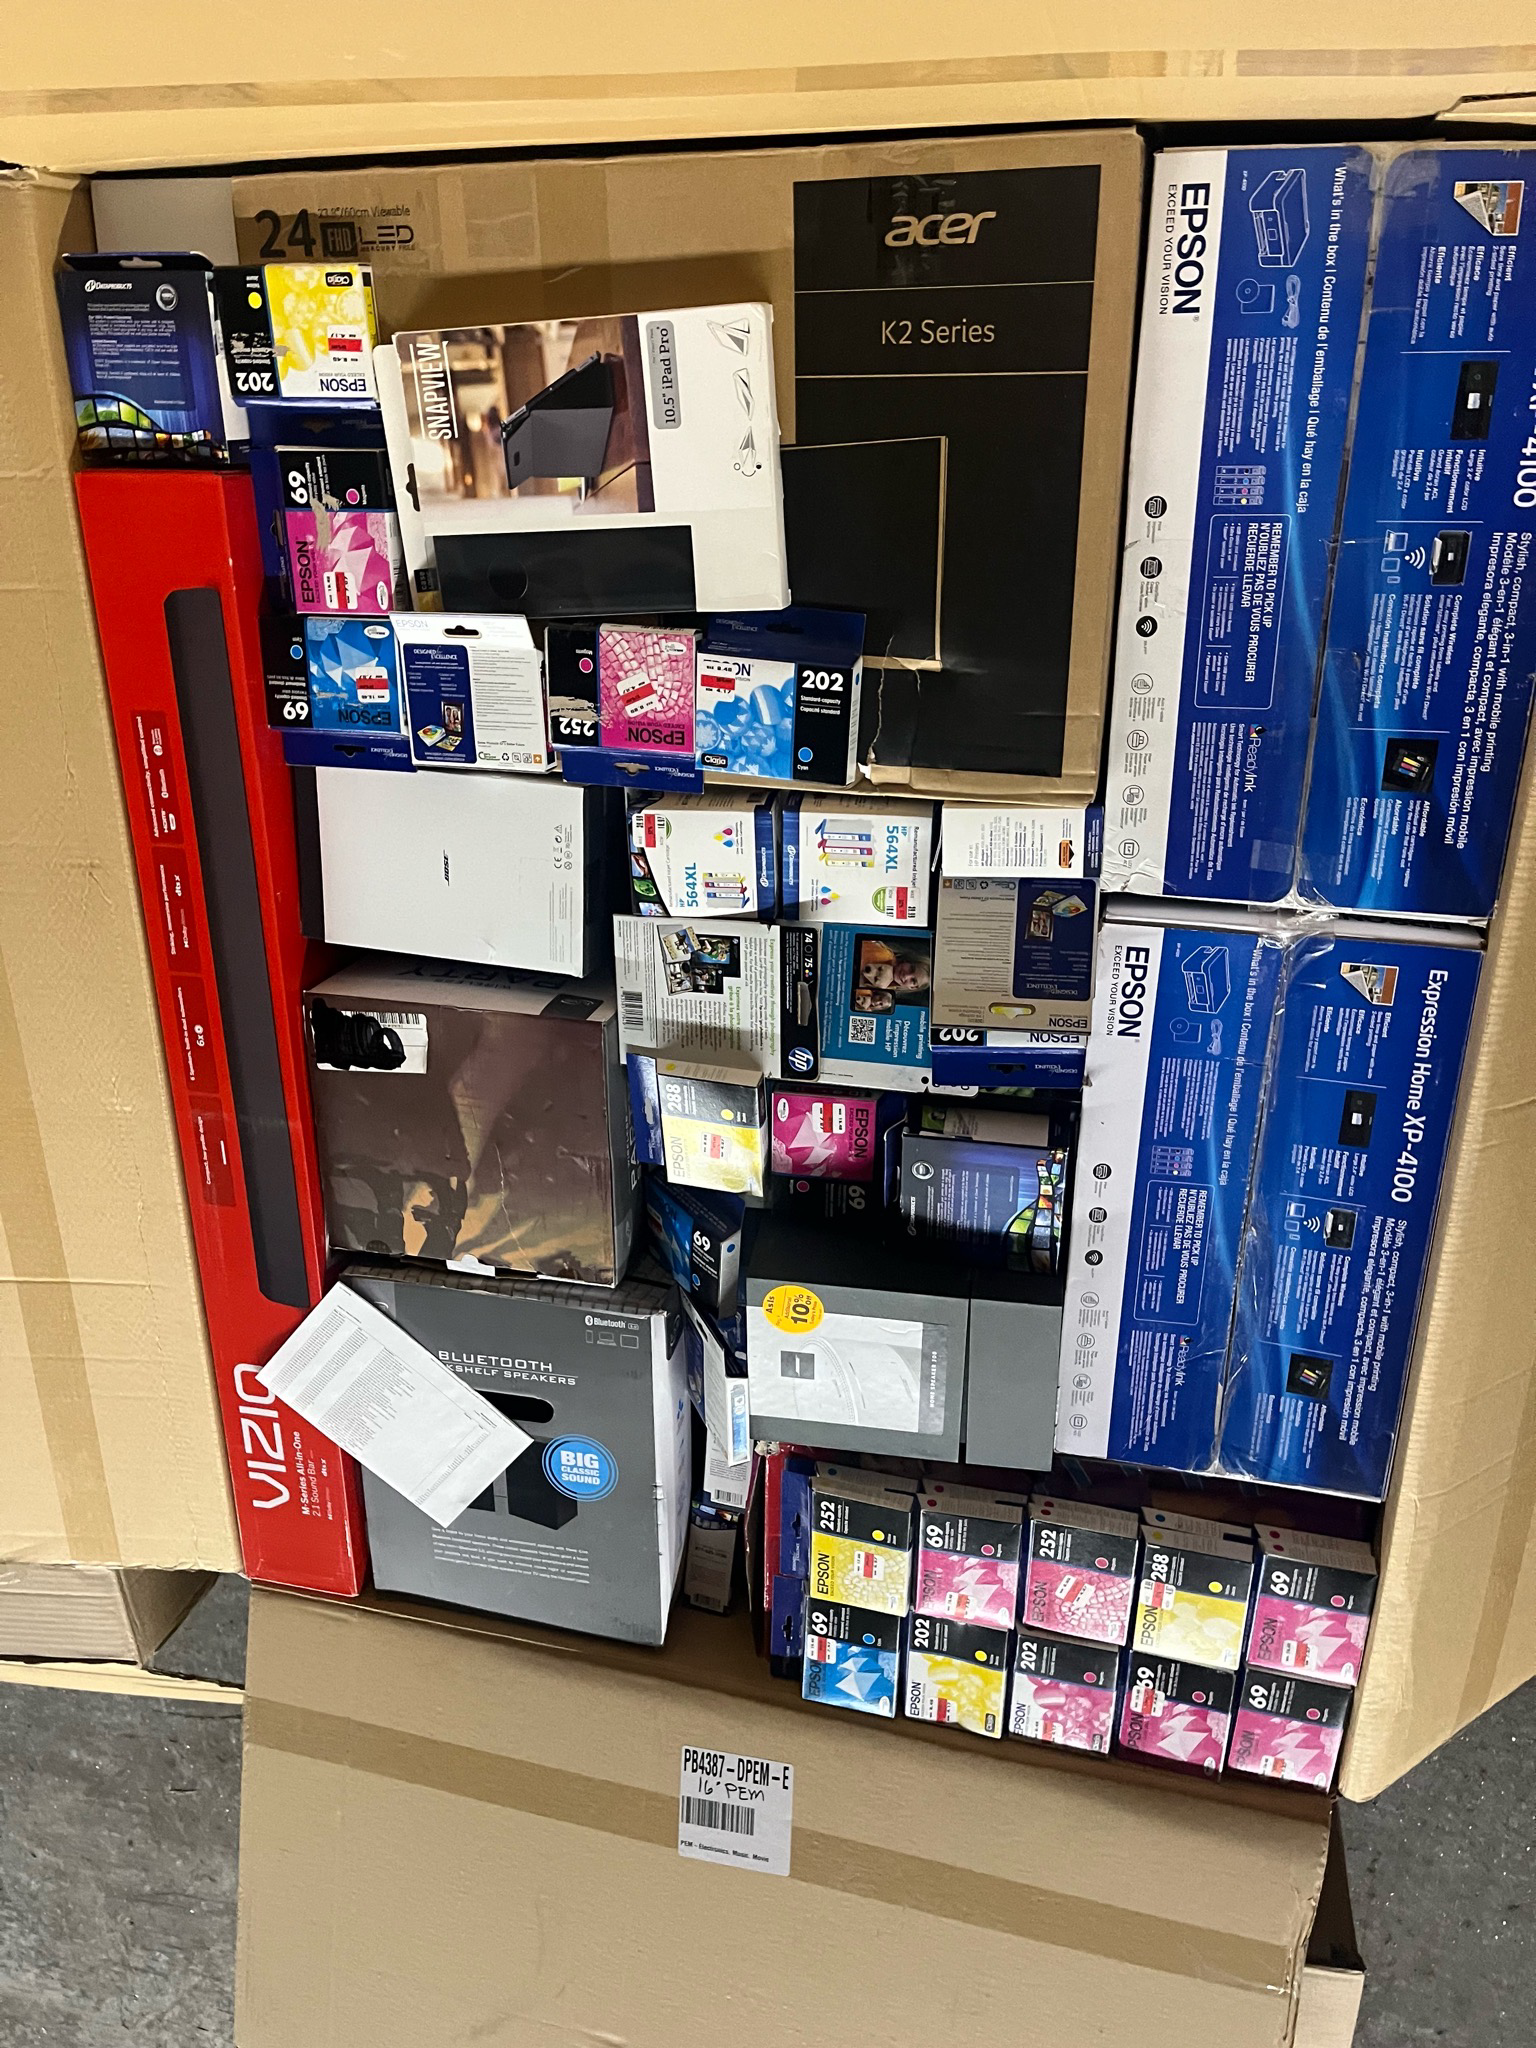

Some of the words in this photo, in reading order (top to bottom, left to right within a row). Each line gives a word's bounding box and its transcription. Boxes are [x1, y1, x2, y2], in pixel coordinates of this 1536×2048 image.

[1331, 167, 1347, 206] What's
[1164, 184, 1177, 233] EXCEED
[1330, 209, 1340, 221] in
[255, 209, 316, 258] 24
[358, 225, 414, 245] LED
[885, 211, 996, 247] acer
[1327, 226, 1339, 243] the
[1161, 237, 1173, 271] YOUR
[1172, 183, 1211, 315] EPSON
[1325, 245, 1338, 267] box
[1159, 275, 1170, 315] VISION
[1319, 276, 1336, 323] Contenu
[656, 326, 671, 353] Pro
[881, 321, 912, 345] K2
[920, 318, 995, 344] Series
[1317, 326, 1331, 340] de
[235, 372, 274, 391] 202
[320, 378, 366, 391] EPSON
[658, 357, 673, 389] iPad
[1308, 343, 1329, 407] l'emballage
[416, 343, 453, 440] SNAPVIEW
[661, 392, 677, 423] 10.5"
[1305, 417, 1321, 437] Qué
[1301, 441, 1317, 460] hay
[1474, 449, 1486, 481] Intuitive
[1300, 479, 1312, 489] la
[1302, 463, 1313, 476] en
[288, 470, 308, 504] 69
[1296, 491, 1310, 513] caja
[1243, 522, 1259, 572] RECUERDE
[1254, 522, 1269, 572] N'OUBLIEZ
[1267, 522, 1282, 577] REMEMBER
[1483, 532, 1503, 590] Impresora
[1500, 532, 1517, 574] Modèle
[1513, 532, 1532, 574] Stylish,
[296, 541, 315, 603] EPSON
[1252, 574, 1264, 591] PAS
[1266, 579, 1278, 590] TO
[1240, 574, 1252, 608] LLEVAR
[1252, 593, 1262, 605] DE
[1263, 592, 1276, 613] PICK
[1494, 577, 1510, 613] 3-en-1
[1504, 577, 1523, 629] compact,
[1248, 607, 1261, 632] VOUS
[1262, 615, 1274, 628] UP
[1450, 594, 1463, 631] Complete
[1474, 592, 1493, 644] elegante,
[1444, 633, 1457, 665] Wireless
[1485, 617, 1503, 659] élégant
[1499, 632, 1515, 663] 3-in-1
[1244, 634, 1259, 682] PROCURER
[1484, 661, 1495, 671] et
[802, 670, 843, 691] 202
[1465, 646, 1484, 703] compacta,
[1496, 667, 1509, 690] with
[283, 702, 308, 720] 69
[801, 695, 841, 705] Standard-capacity
[1475, 674, 1492, 725] compact,
[1489, 693, 1505, 729] mobile
[338, 710, 392, 725] EPSON
[559, 717, 595, 736] 252
[1462, 716, 1472, 730] en
[628, 727, 685, 745] EPSON
[1471, 728, 1483, 753] avec
[704, 755, 726, 765] Claria
[1244, 738, 1261, 792] ReadyInk
[1457, 741, 1469, 761] con
[1480, 732, 1499, 772] printing
[1446, 764, 1465, 814] impresión
[1462, 755, 1481, 812] impression
[901, 826, 907, 836] HP
[1444, 816, 1457, 845] móvil
[1456, 815, 1470, 849] mobile
[886, 826, 898, 873] 564XL
[685, 863, 698, 907] 564XL
[679, 899, 685, 907] HP
[804, 932, 813, 943] 74
[804, 957, 813, 968] 75
[1111, 945, 1122, 980] EXCEED
[1108, 982, 1119, 1005] YOUR
[1117, 946, 1150, 1039] EPSON
[1049, 1018, 1088, 1027] EPSON
[1105, 1008, 1116, 1036] VISION
[1416, 969, 1448, 1058] Expression
[885, 1042, 890, 1052] HP
[892, 1020, 902, 1058] l'impression
[901, 1021, 910, 1053] Découvrez
[916, 1034, 924, 1059] printing
[939, 1028, 979, 1041] 202
[789, 1049, 812, 1069] hp
[666, 1084, 682, 1112] 288
[1407, 1062, 1431, 1110] Home
[854, 1108, 869, 1159] EPSON
[1391, 1113, 1426, 1203] XP-4100
[849, 1185, 865, 1209] 69
[693, 1230, 711, 1252] 69
[593, 1318, 626, 1329] Bluetooth
[790, 1294, 810, 1324] 10%
[438, 1350, 553, 1373] BLUETOOTH
[446, 1363, 499, 1376] KSHELF
[503, 1371, 576, 1386] SPEAKERS
[234, 1363, 290, 1509] VIZIO
[292, 1431, 305, 1475] All-in-One
[307, 1460, 315, 1475] Bar
[560, 1450, 599, 1470] BIG
[561, 1466, 599, 1477] CLASSIC
[561, 1473, 600, 1485] SOUND
[298, 1477, 310, 1515] M-Series
[308, 1477, 319, 1503] Sound
[312, 1505, 321, 1517] 2.1
[820, 1501, 835, 1531] 252
[926, 1525, 943, 1548] 69
[1040, 1529, 1056, 1558] 252
[817, 1553, 829, 1595] EPSON
[1150, 1554, 1169, 1582] 288
[1270, 1570, 1290, 1596] 69
[1032, 1581, 1048, 1623] EPSON
[812, 1611, 828, 1635] 69
[914, 1618, 930, 1648] 202
[1140, 1606, 1157, 1646] EPSON
[1257, 1618, 1278, 1660] EPSON
[1021, 1641, 1037, 1671] 202
[1136, 1666, 1155, 1688] 69
[910, 1682, 922, 1716] EPSON
[1248, 1684, 1268, 1708] 69
[684, 1748, 790, 1790] PB4387-DPEM-E
[724, 1783, 765, 1802] PEM
